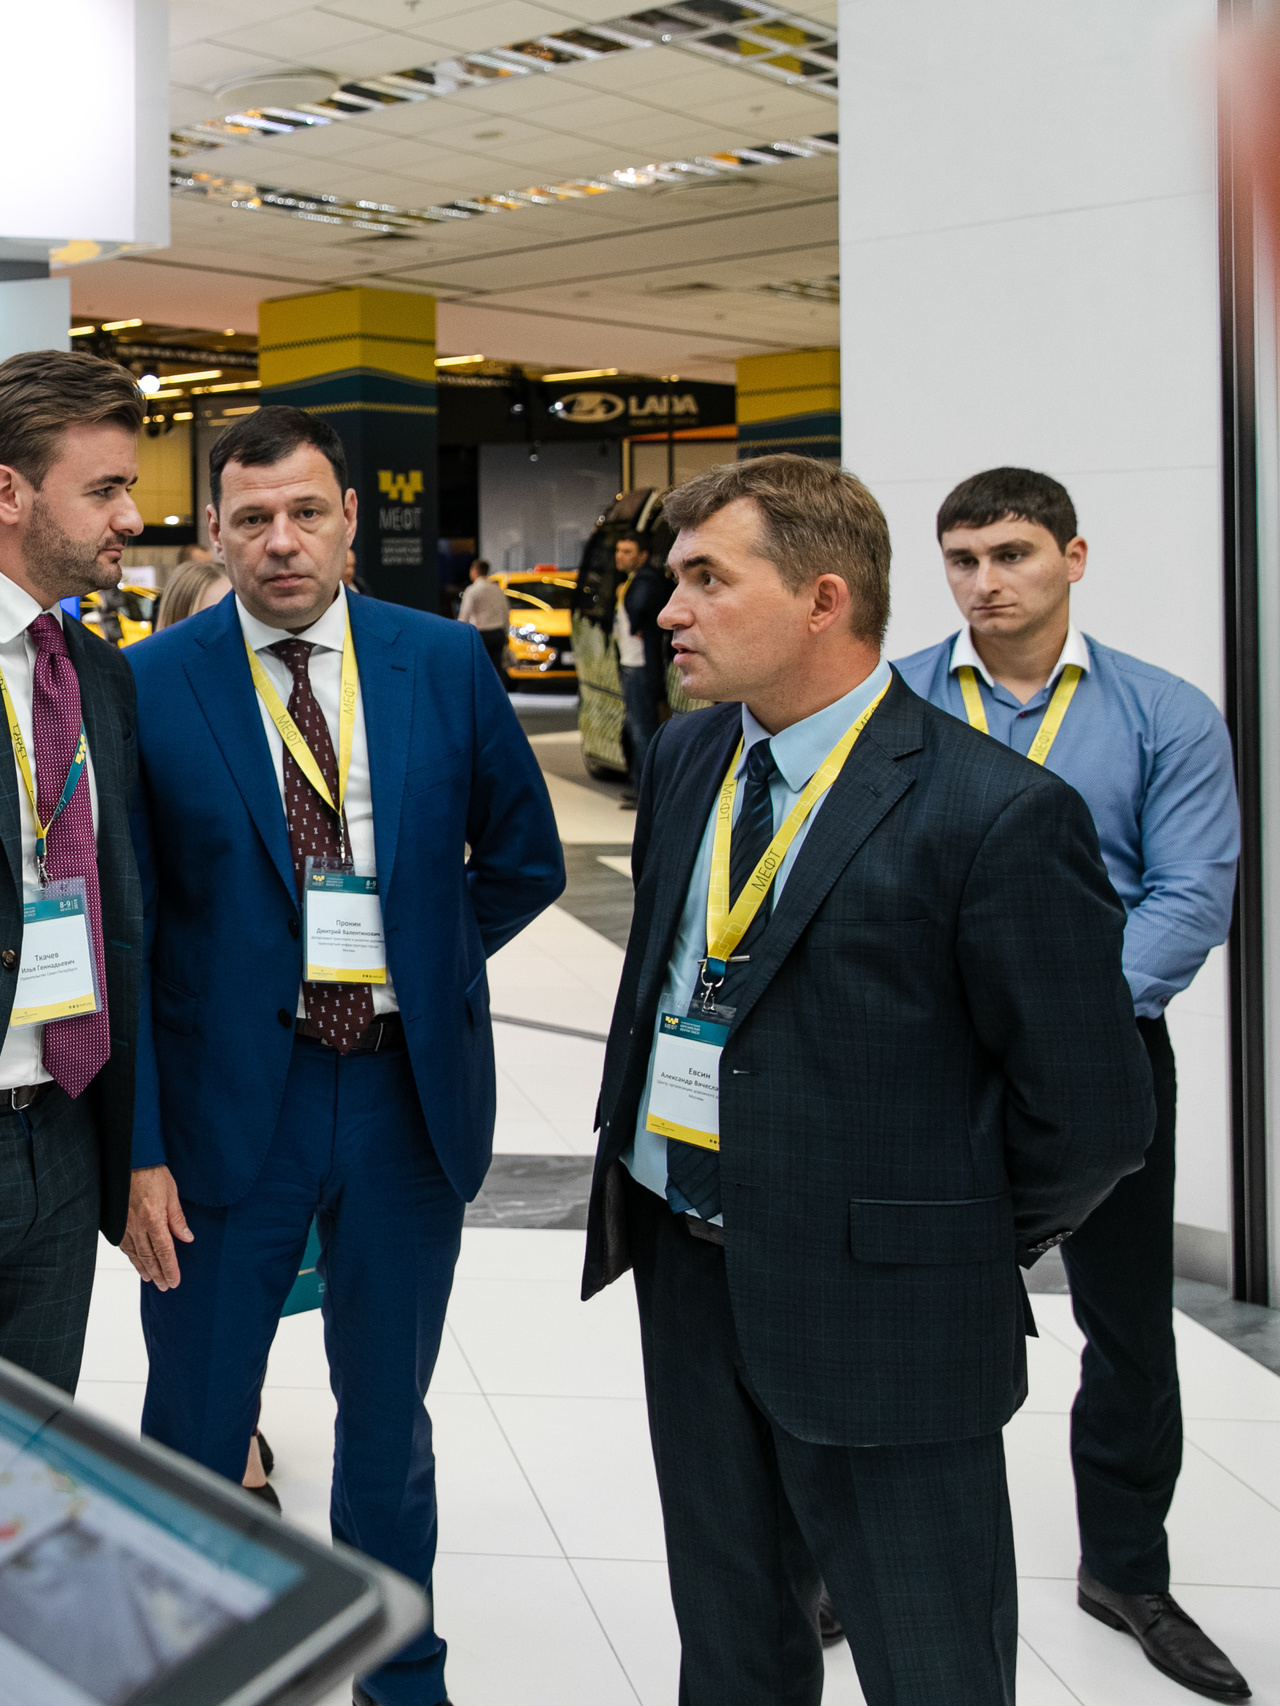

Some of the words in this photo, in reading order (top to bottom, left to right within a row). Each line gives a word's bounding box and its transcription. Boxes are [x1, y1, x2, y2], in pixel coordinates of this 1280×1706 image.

[379, 506, 422, 531] МЕФТ
[343, 680, 356, 716] МЕФТ
[276, 713, 304, 748] МЕФТ
[718, 783, 736, 822] МЕФТ
[751, 847, 781, 892] МЕФТ
[59, 900, 71, 909] 8-9
[335, 919, 362, 928] Пронин
[342, 929, 381, 937] Валентинович
[34, 952, 60, 962] Ткачев
[21, 966, 36, 974] Илья
[36, 959, 75, 971] Геннадьевич
[660, 1072, 693, 1086] Александр
[688, 1067, 711, 1080] Евсин
